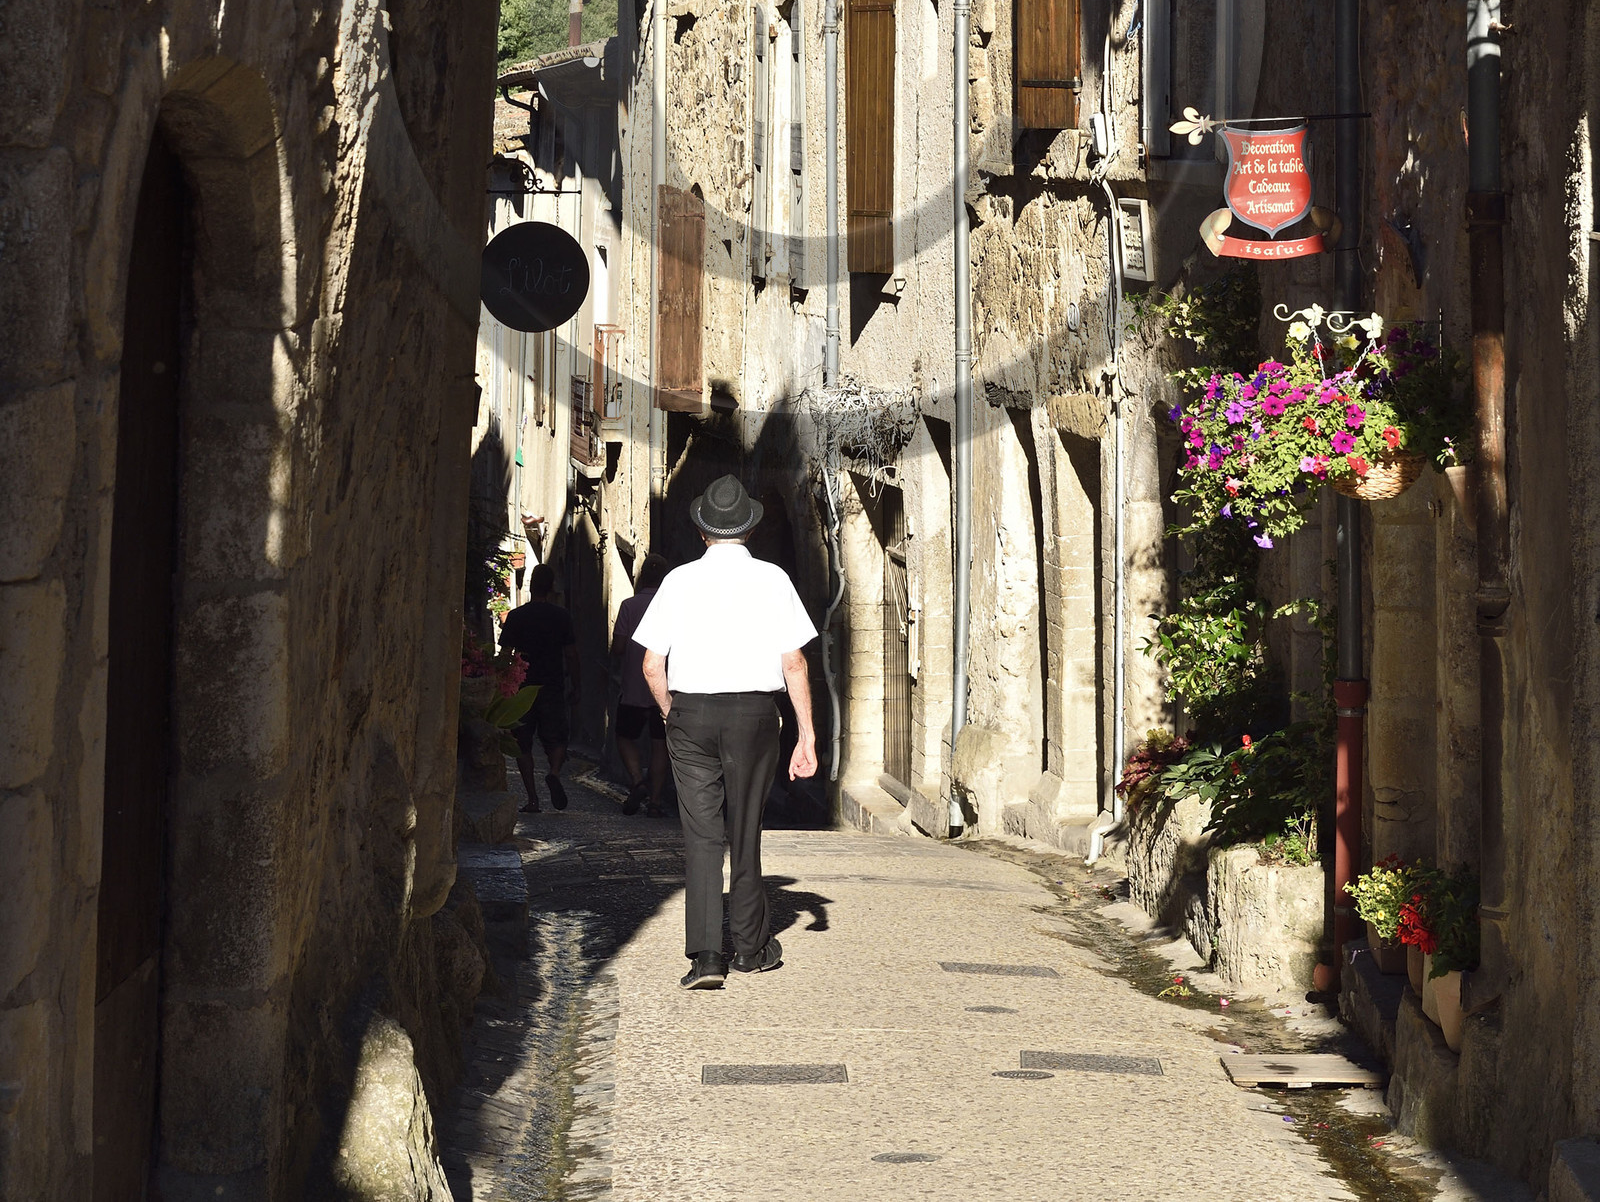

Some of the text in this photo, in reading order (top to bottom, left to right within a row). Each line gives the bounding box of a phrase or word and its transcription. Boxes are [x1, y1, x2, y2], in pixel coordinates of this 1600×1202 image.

[1241, 140, 1295, 155] Décoration
[1234, 158, 1304, 175] Art de la table
[1249, 178, 1290, 194] Cadeaux
[1247, 200, 1294, 214] Artisanat
